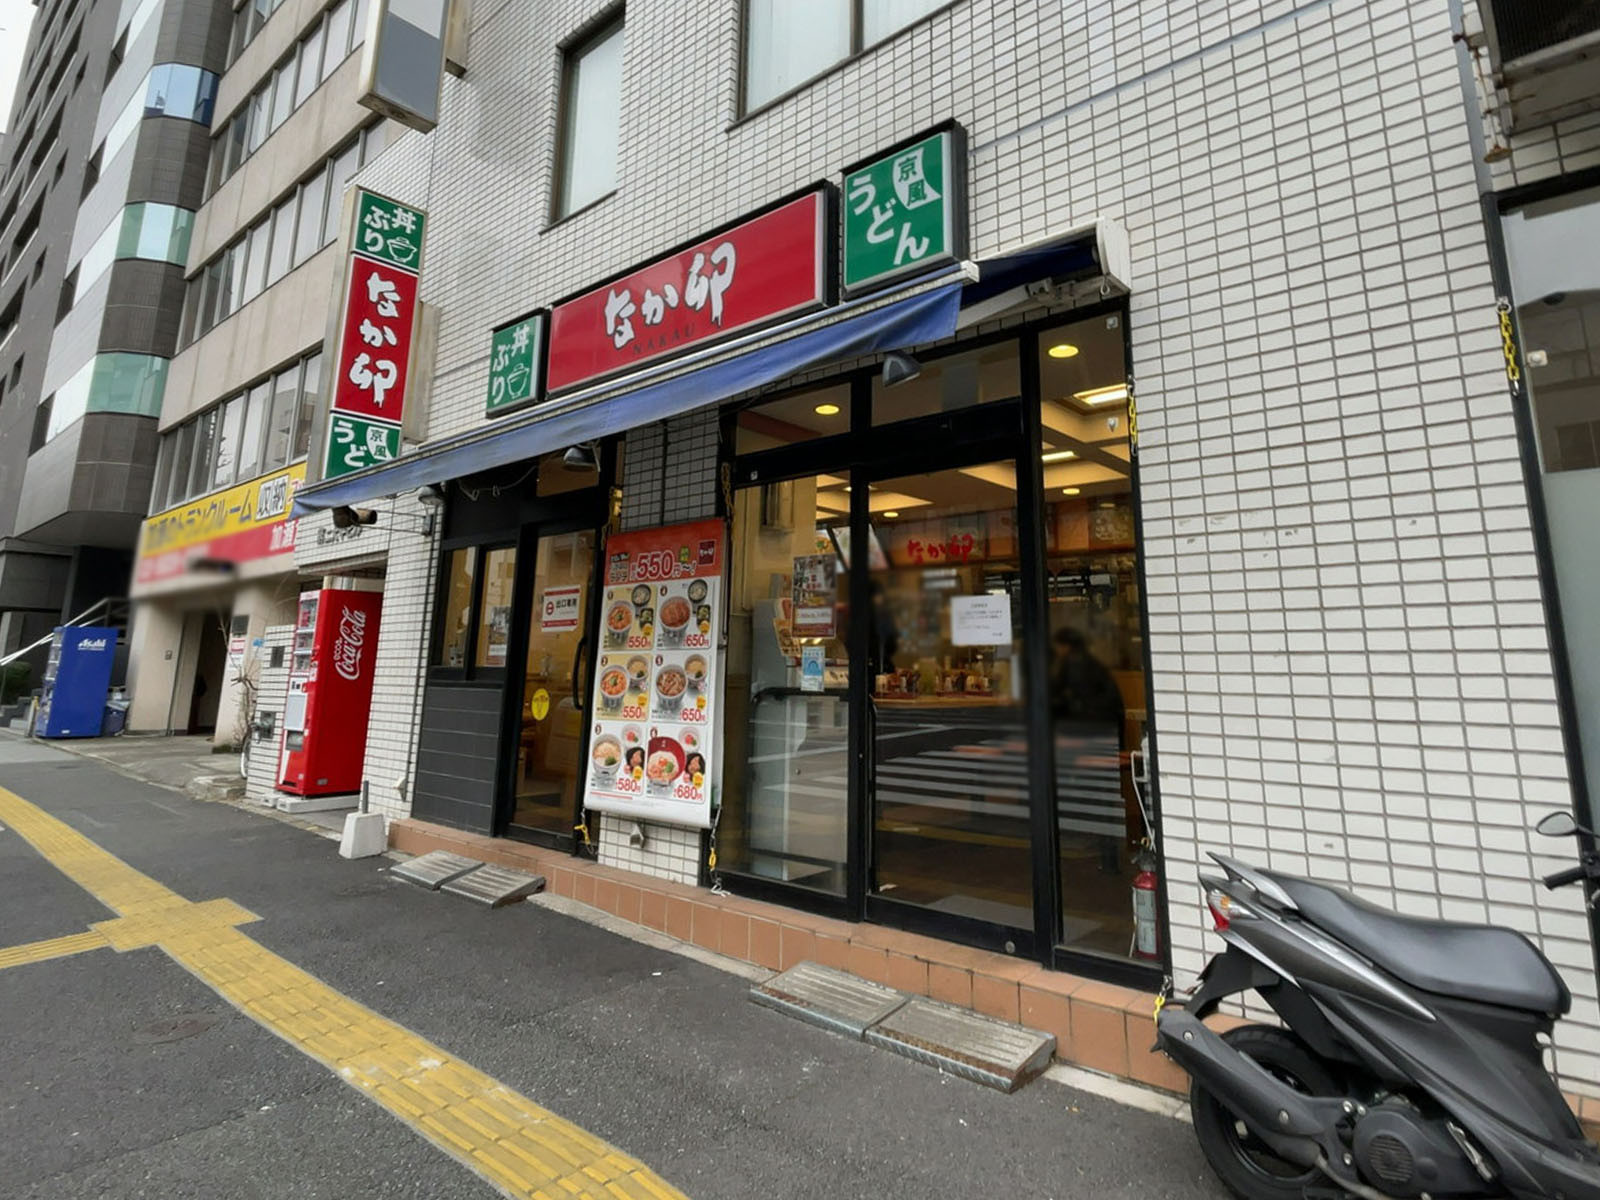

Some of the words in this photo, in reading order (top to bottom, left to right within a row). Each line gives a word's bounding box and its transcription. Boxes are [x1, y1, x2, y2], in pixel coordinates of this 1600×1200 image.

[899, 159, 927, 203] 京風
[364, 205, 417, 253] 丼ぶり
[848, 173, 930, 265] うどん
[604, 242, 736, 350] なか卯
[349, 272, 401, 408] なか卯
[492, 323, 530, 405] 丼ぶり
[633, 324, 697, 356] NAKAU
[333, 421, 375, 467] うど
[370, 428, 387, 458] 京風
[906, 533, 975, 564] なか卯
[335, 605, 366, 680] Coca-Cola
